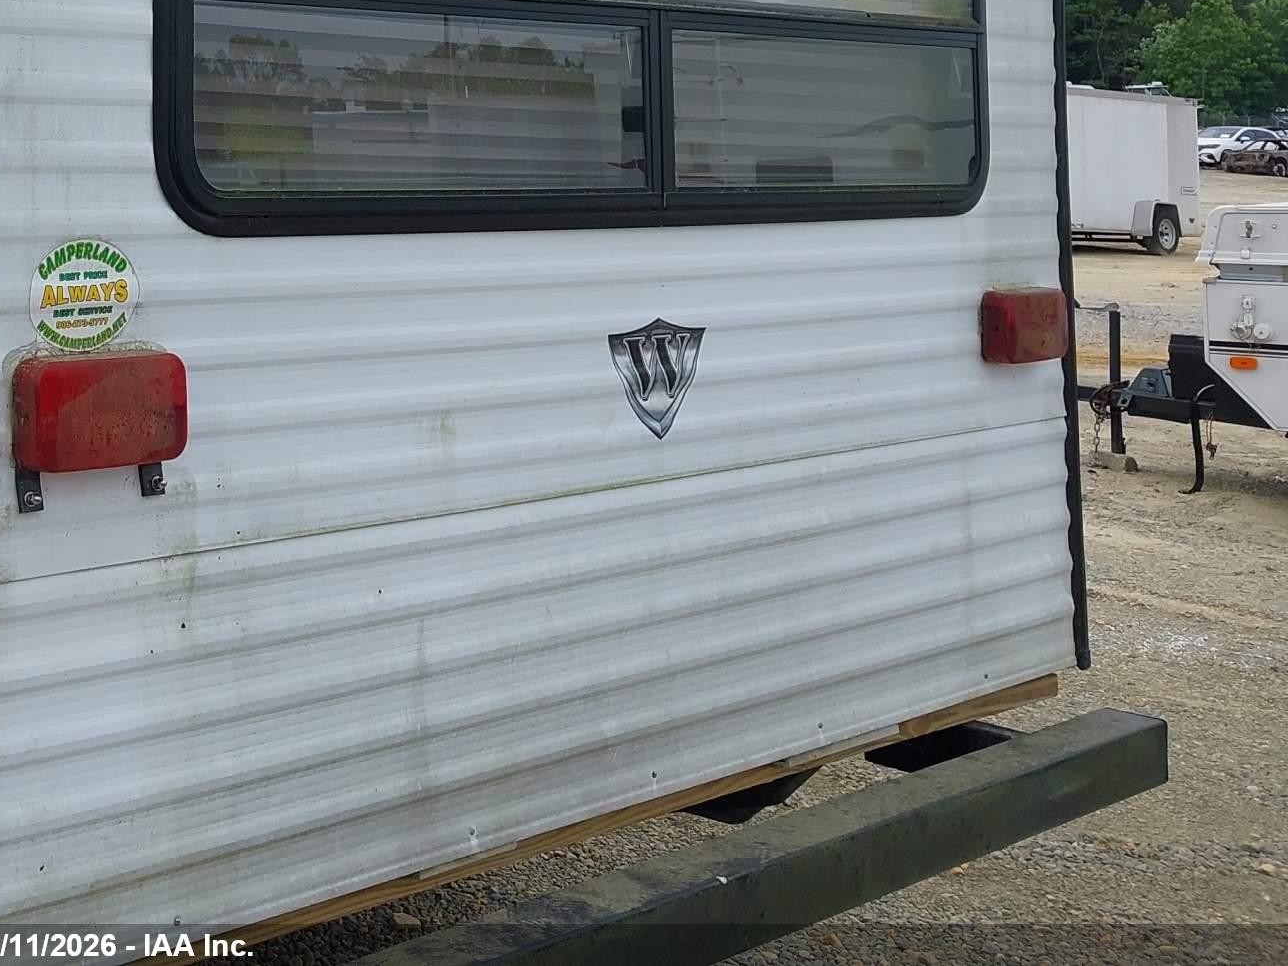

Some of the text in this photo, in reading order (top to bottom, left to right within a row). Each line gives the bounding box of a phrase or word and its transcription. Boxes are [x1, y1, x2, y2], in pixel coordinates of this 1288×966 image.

[38, 242, 127, 280] CAMPERLAND
[59, 271, 108, 281] BEST PRICE
[40, 279, 128, 309] ALWAYS
[53, 306, 113, 318] BEST SERVICE
[37, 312, 127, 349] WWW.CAMPERLAND.NET
